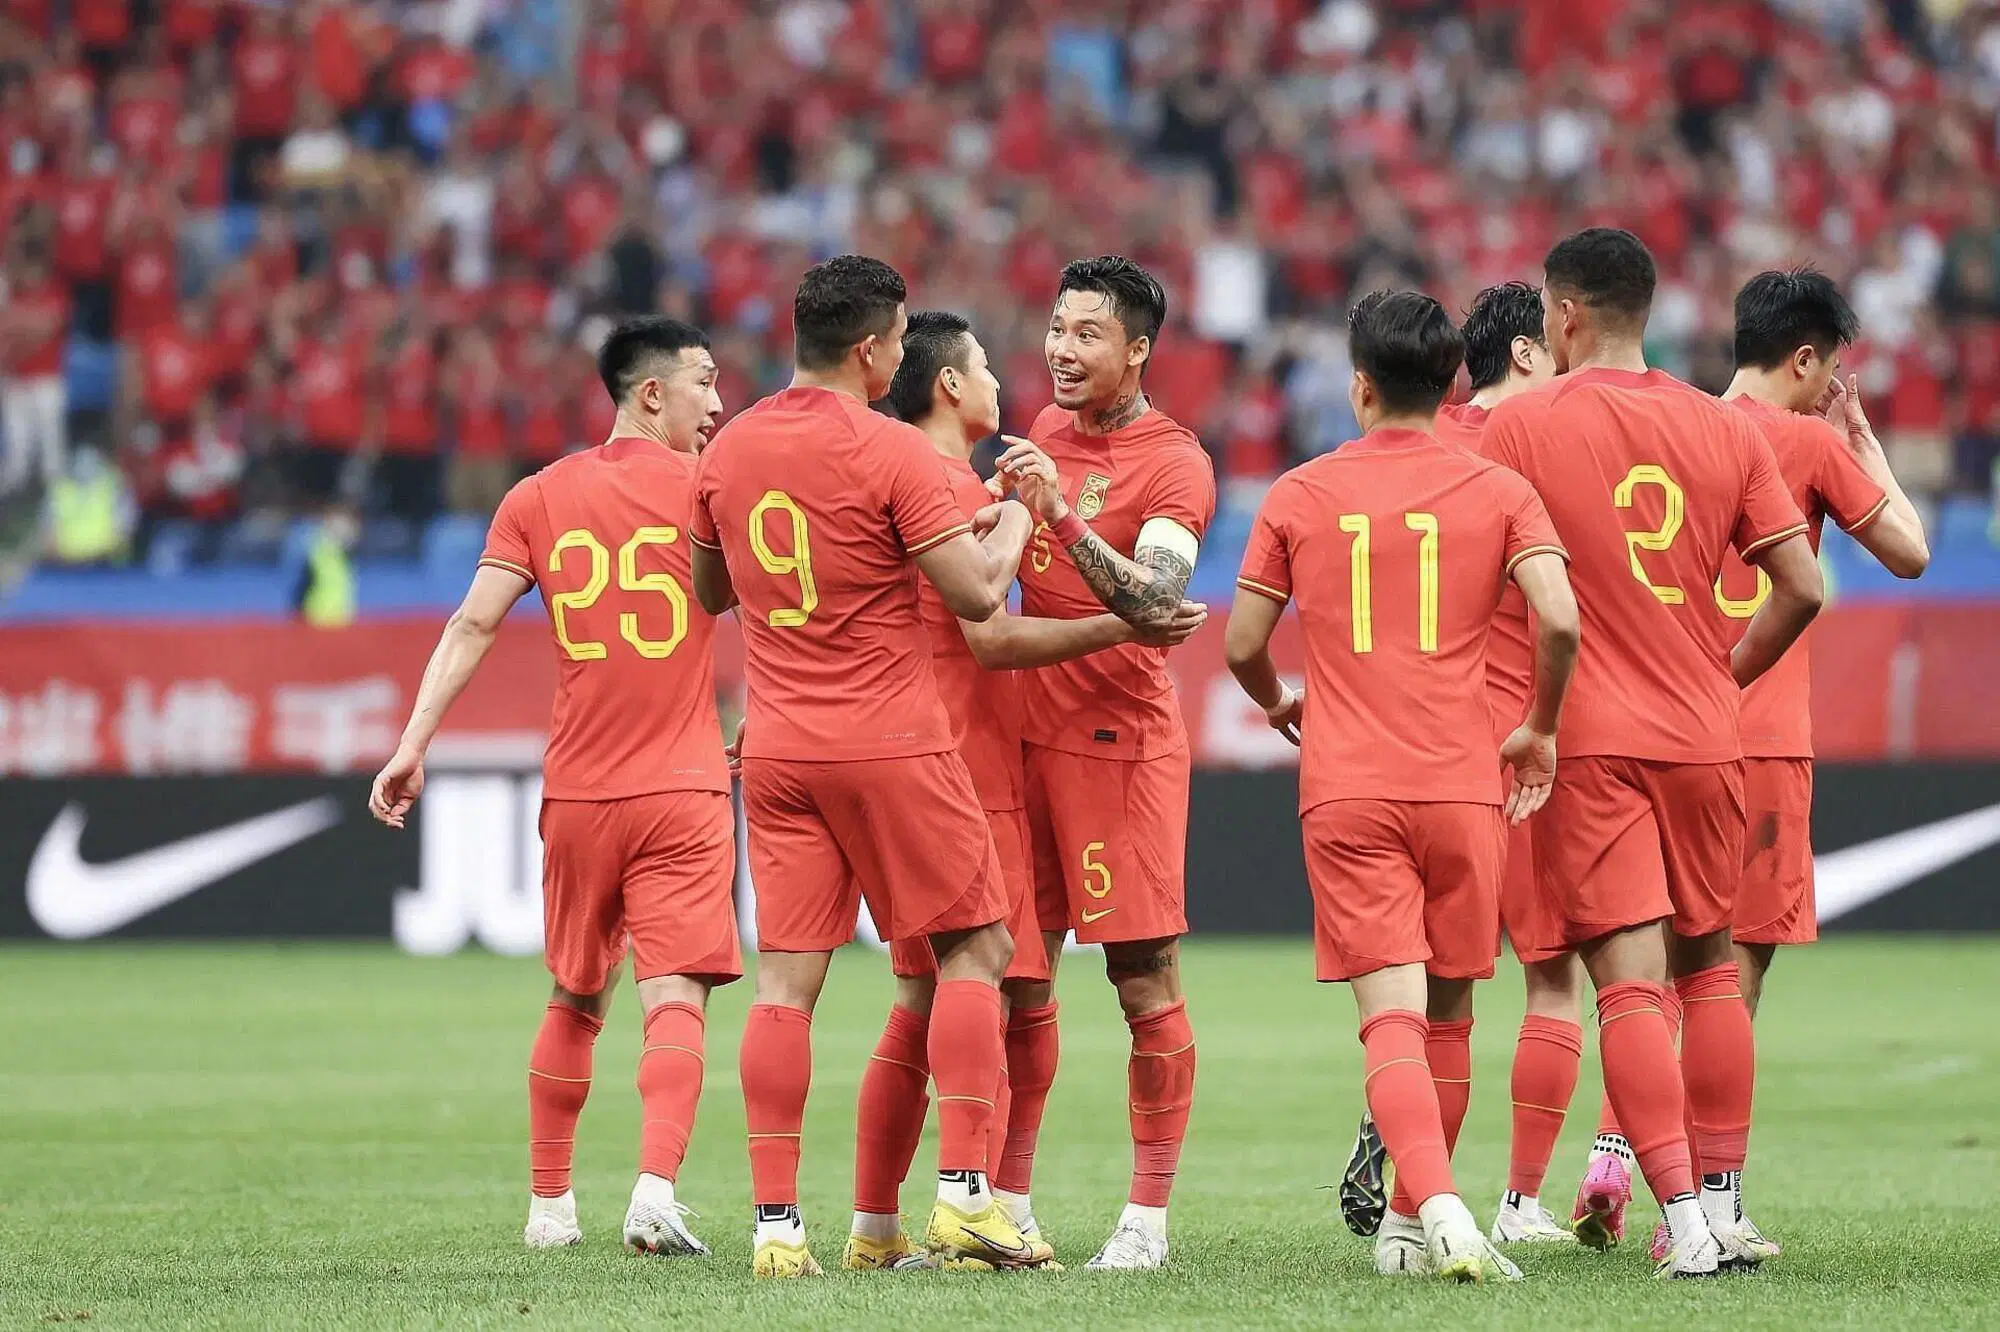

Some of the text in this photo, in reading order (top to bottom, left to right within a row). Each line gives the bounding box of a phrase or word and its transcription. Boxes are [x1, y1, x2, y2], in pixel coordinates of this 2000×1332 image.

[549, 526, 689, 661] 25
[747, 488, 819, 628] 9
[1031, 520, 1052, 575] 5
[1338, 512, 1440, 654] 11
[1613, 463, 1685, 605] 2
[1082, 840, 1113, 899] 5
